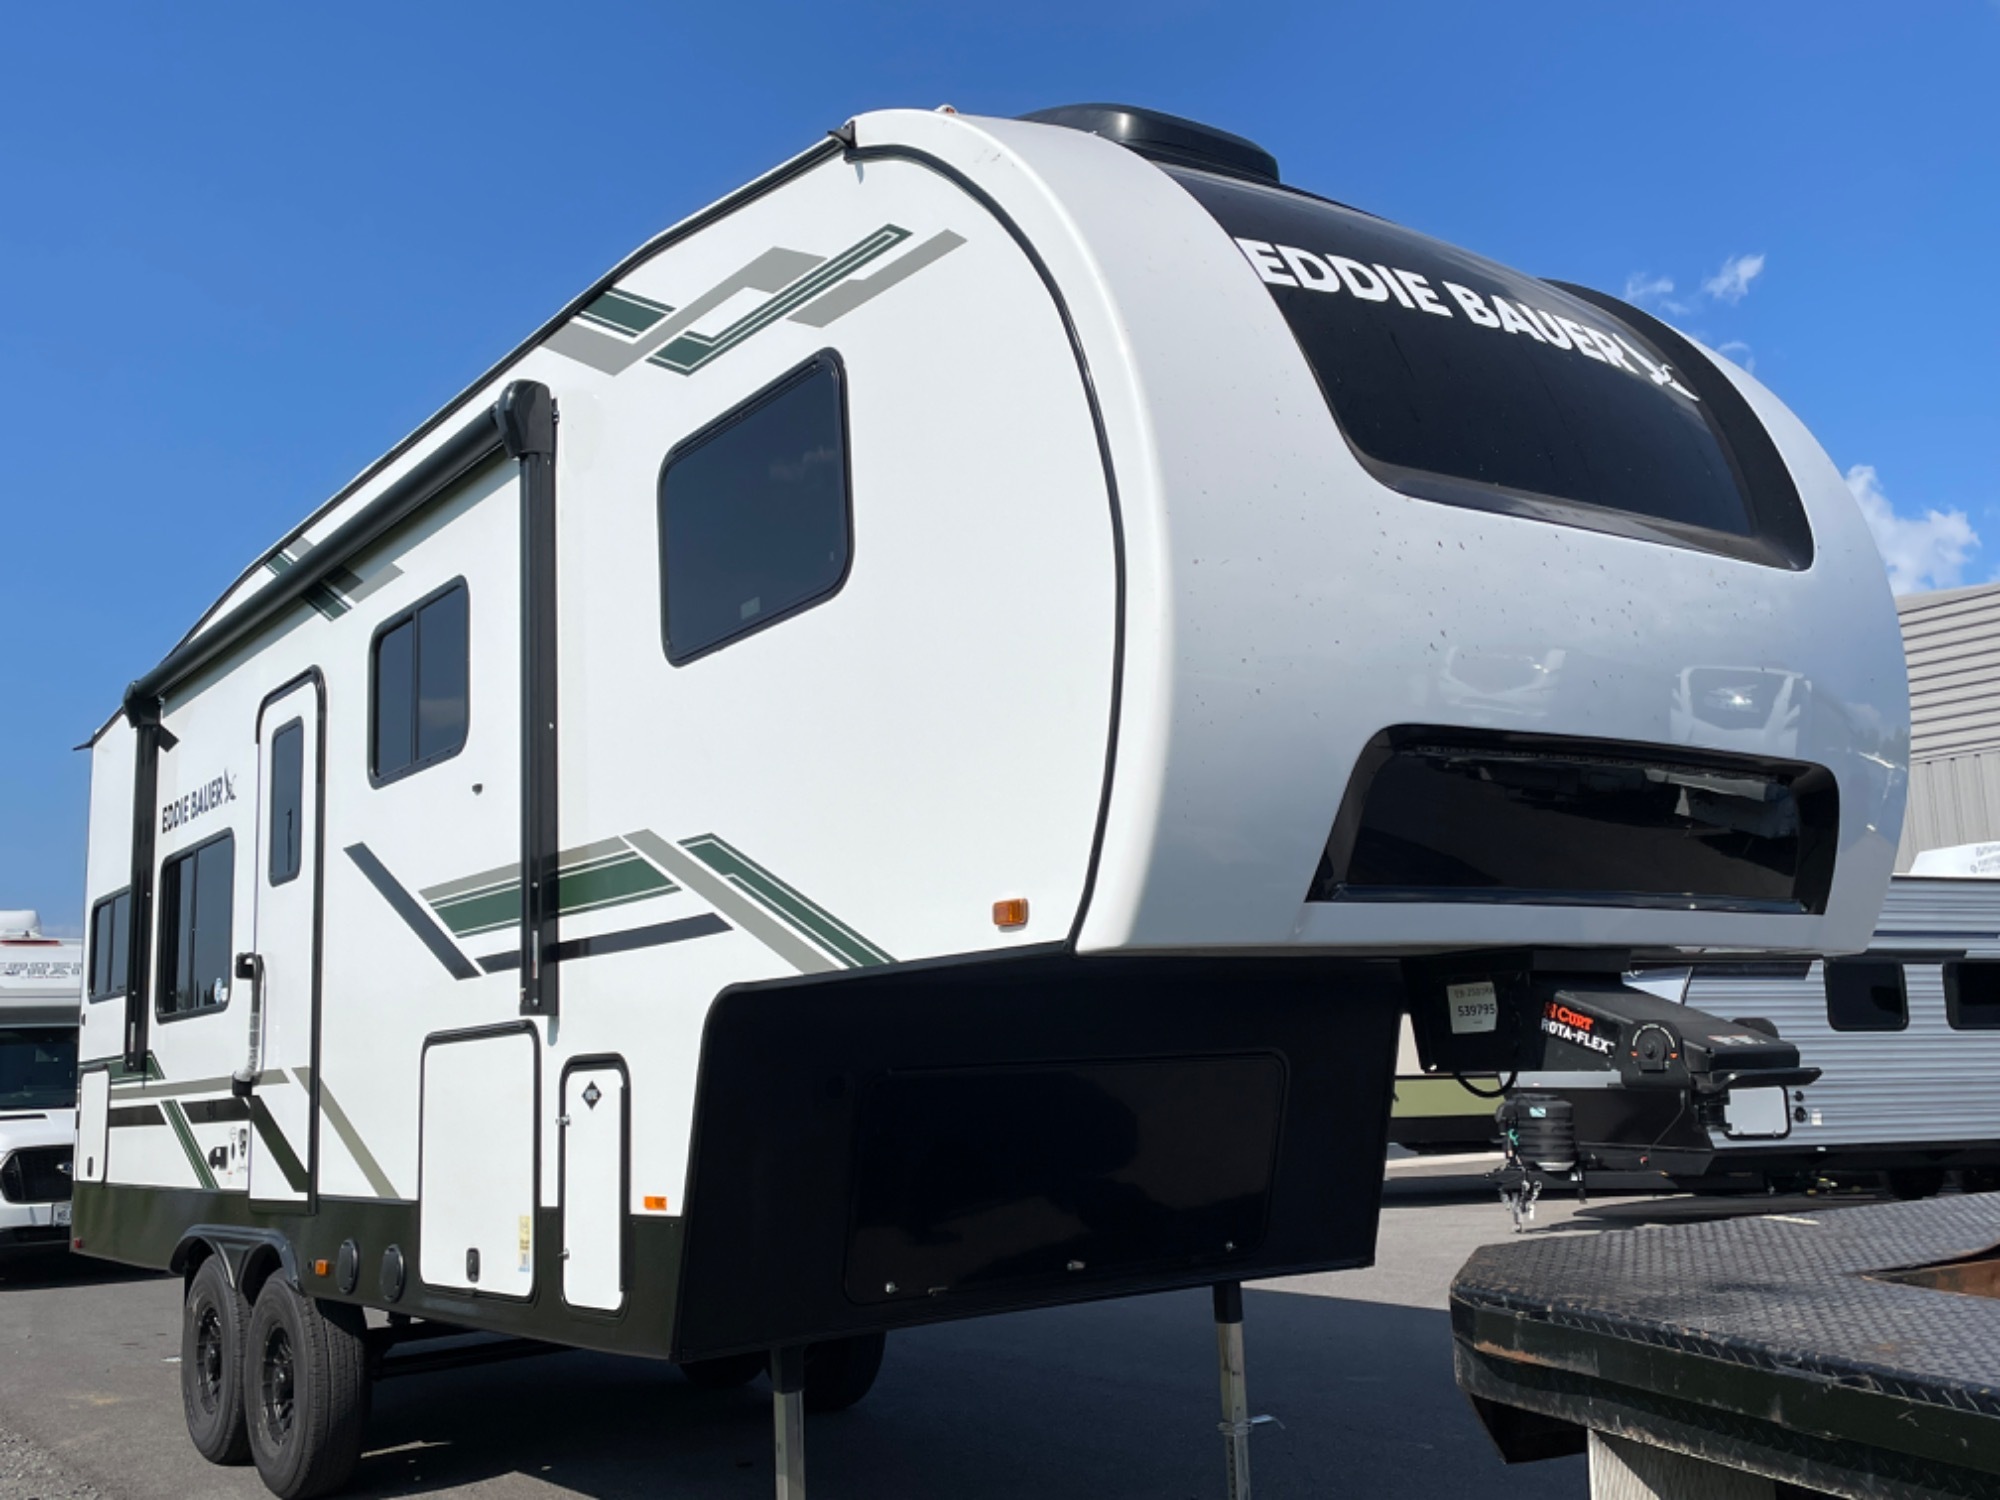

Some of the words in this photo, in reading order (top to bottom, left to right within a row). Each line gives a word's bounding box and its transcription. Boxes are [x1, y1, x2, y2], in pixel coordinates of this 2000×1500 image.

[1234, 237, 1453, 317] EDDIE
[1442, 280, 1640, 375] BAUER
[162, 795, 189, 833] EDDIE
[190, 776, 223, 820] BAUER
[1457, 1003, 1496, 1017] 539795
